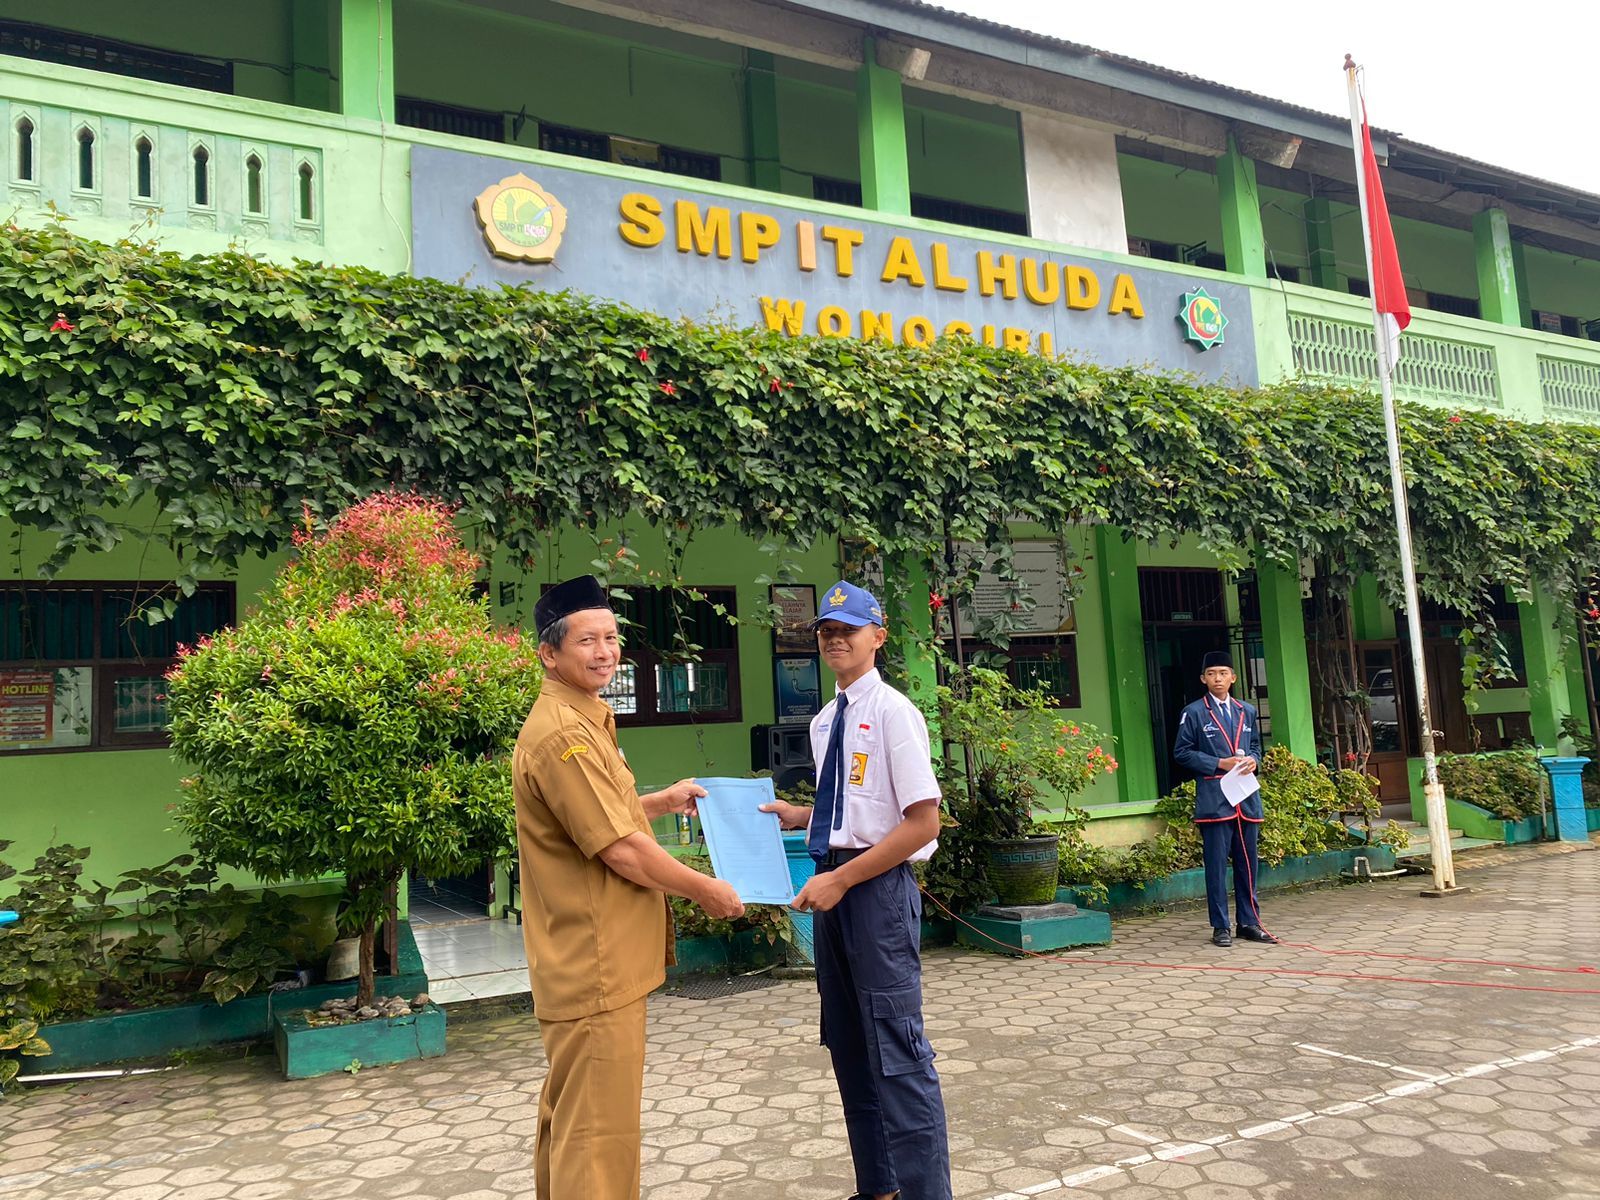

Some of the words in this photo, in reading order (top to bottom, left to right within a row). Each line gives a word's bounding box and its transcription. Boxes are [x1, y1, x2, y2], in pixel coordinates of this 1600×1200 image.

[618, 192, 781, 264] SMP
[797, 219, 863, 277] IT
[2, 685, 49, 695] HOTLINE
